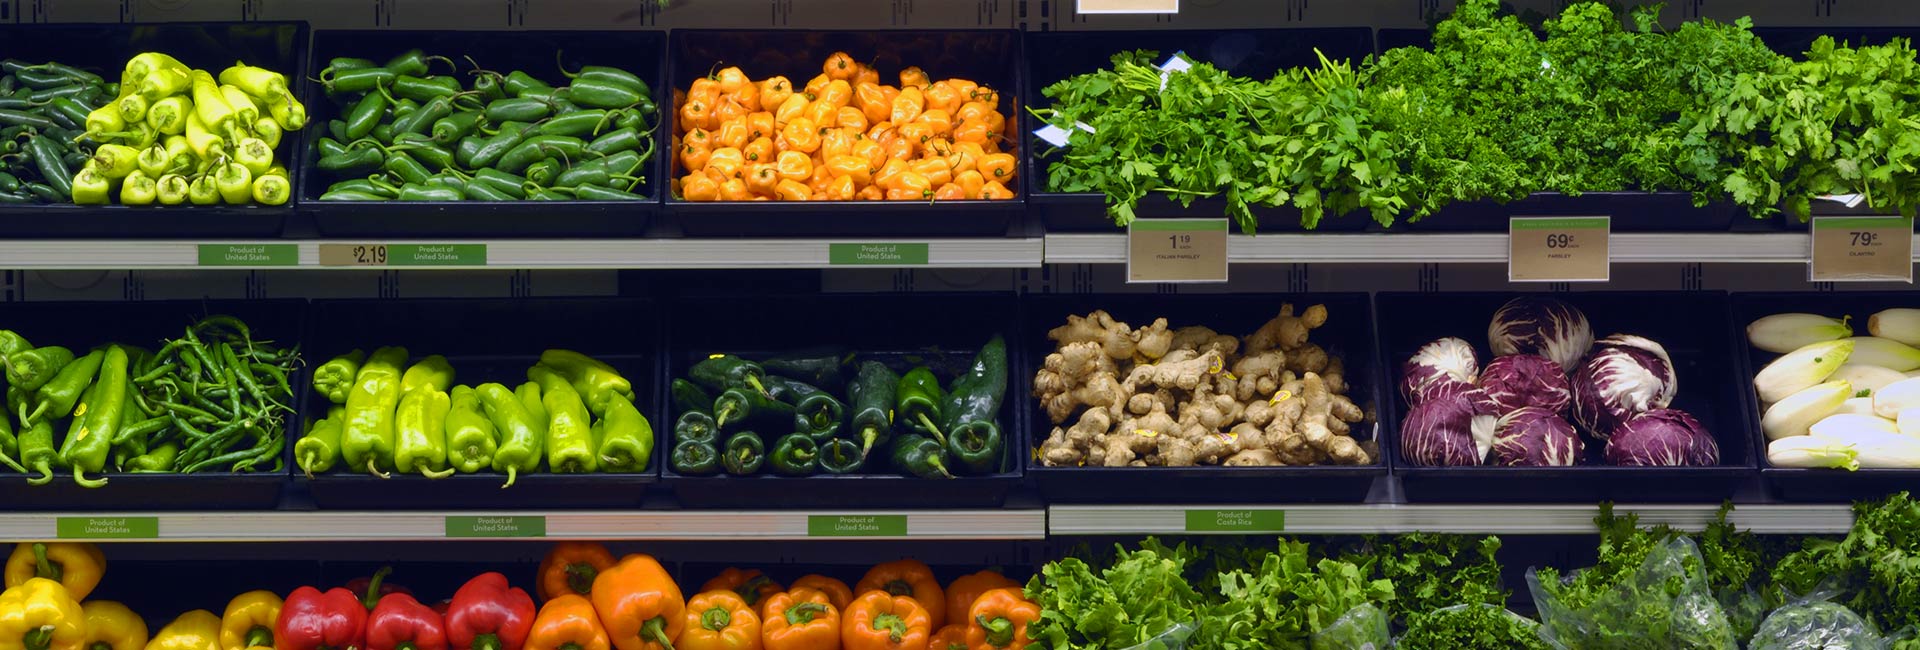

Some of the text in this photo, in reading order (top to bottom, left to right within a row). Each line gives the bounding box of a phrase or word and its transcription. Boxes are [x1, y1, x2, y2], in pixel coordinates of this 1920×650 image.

[230, 246, 265, 254] Product of
[861, 245, 896, 253] Product of
[225, 253, 270, 261] United States
[353, 245, 387, 264] $2.19
[414, 253, 459, 261] United States
[857, 252, 901, 260] United States
[1217, 511, 1252, 519] Product of
[90, 519, 125, 527] Product of
[478, 517, 513, 525] Product of
[840, 516, 875, 524] Product of
[1217, 518, 1252, 526] Costa Rica
[85, 526, 130, 534] United States
[473, 524, 518, 532] United States
[835, 523, 879, 531] United States
